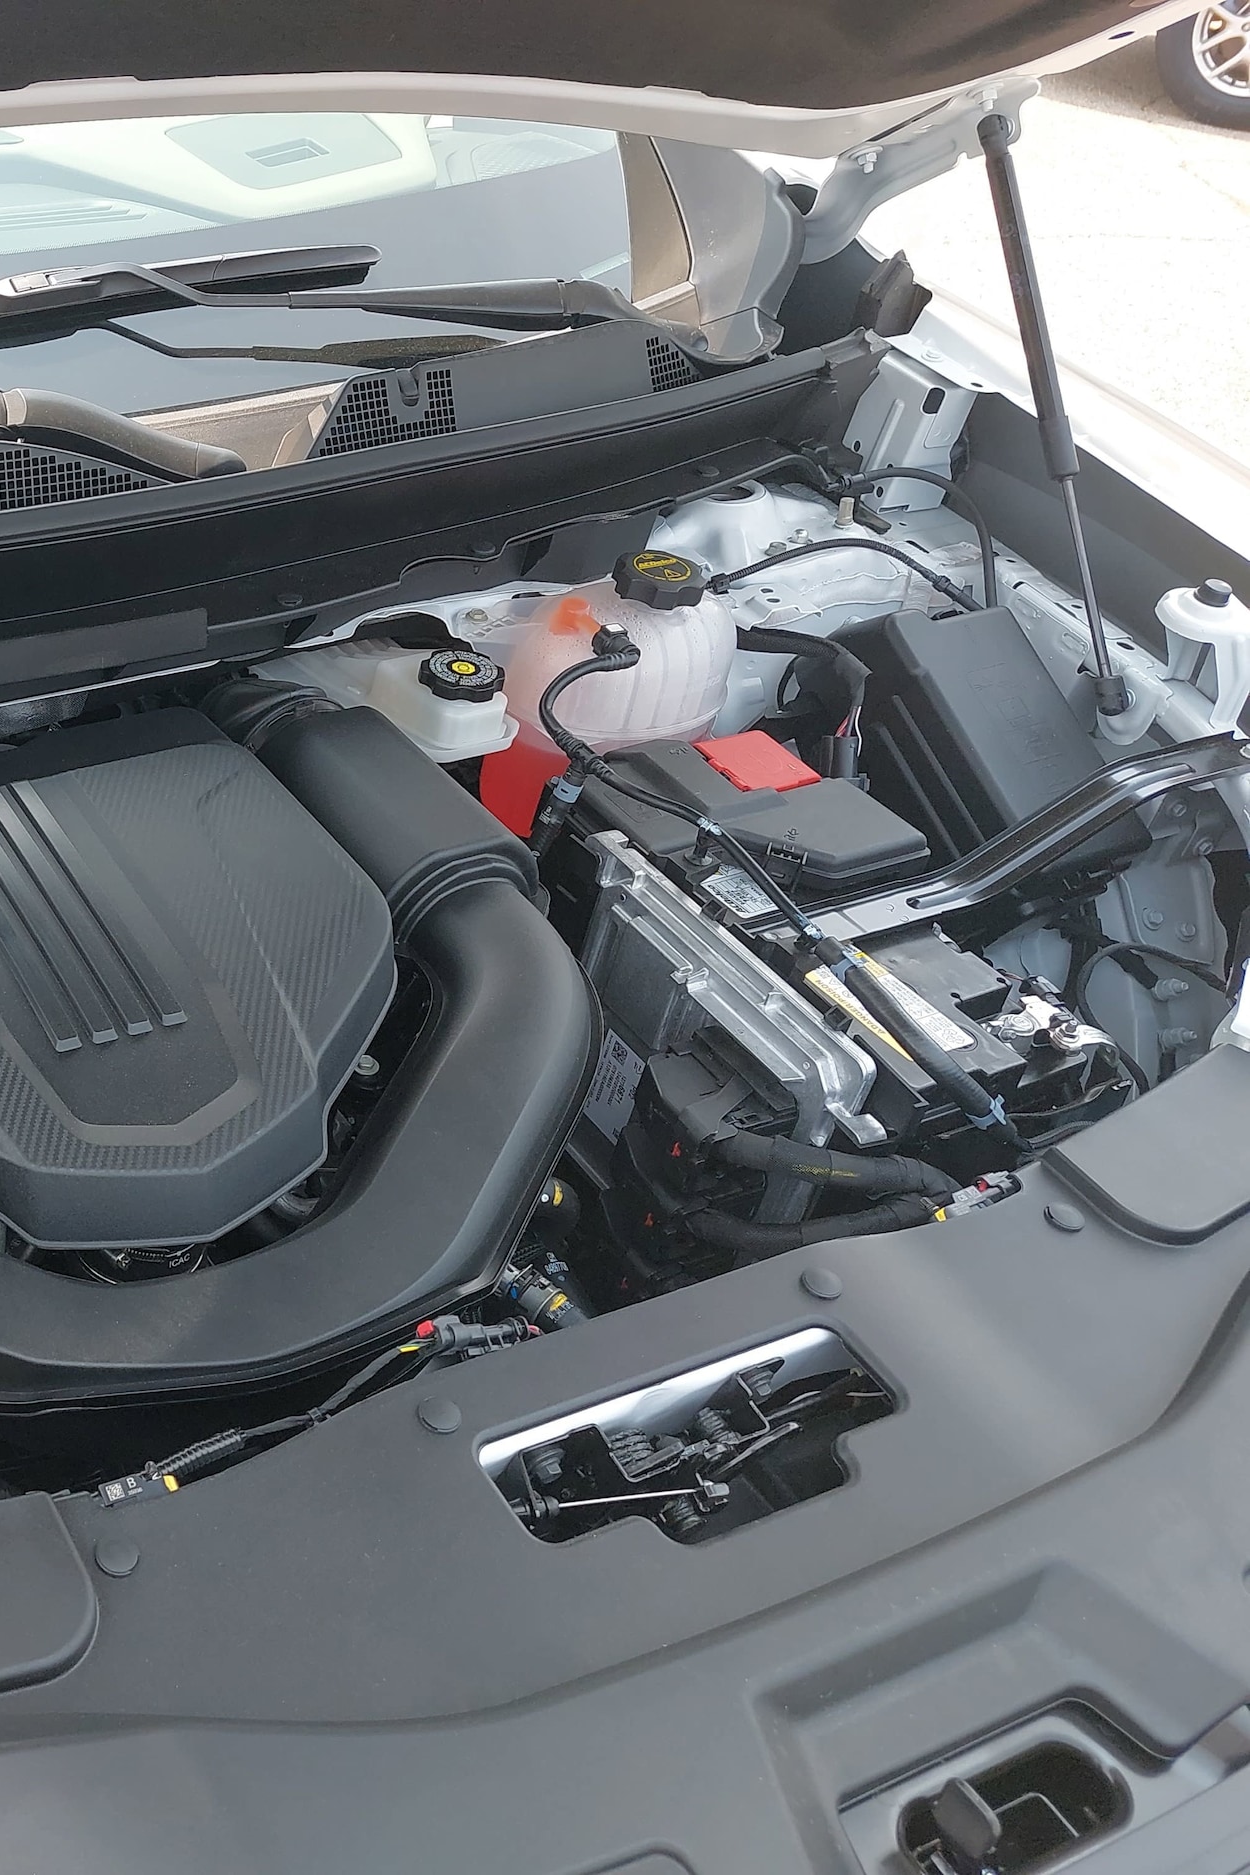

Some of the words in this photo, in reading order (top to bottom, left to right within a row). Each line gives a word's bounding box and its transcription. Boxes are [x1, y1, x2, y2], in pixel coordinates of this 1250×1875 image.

[638, 559, 677, 570] ACDelco
[707, 885, 746, 913] ACDelco
[126, 1477, 137, 1488] B
